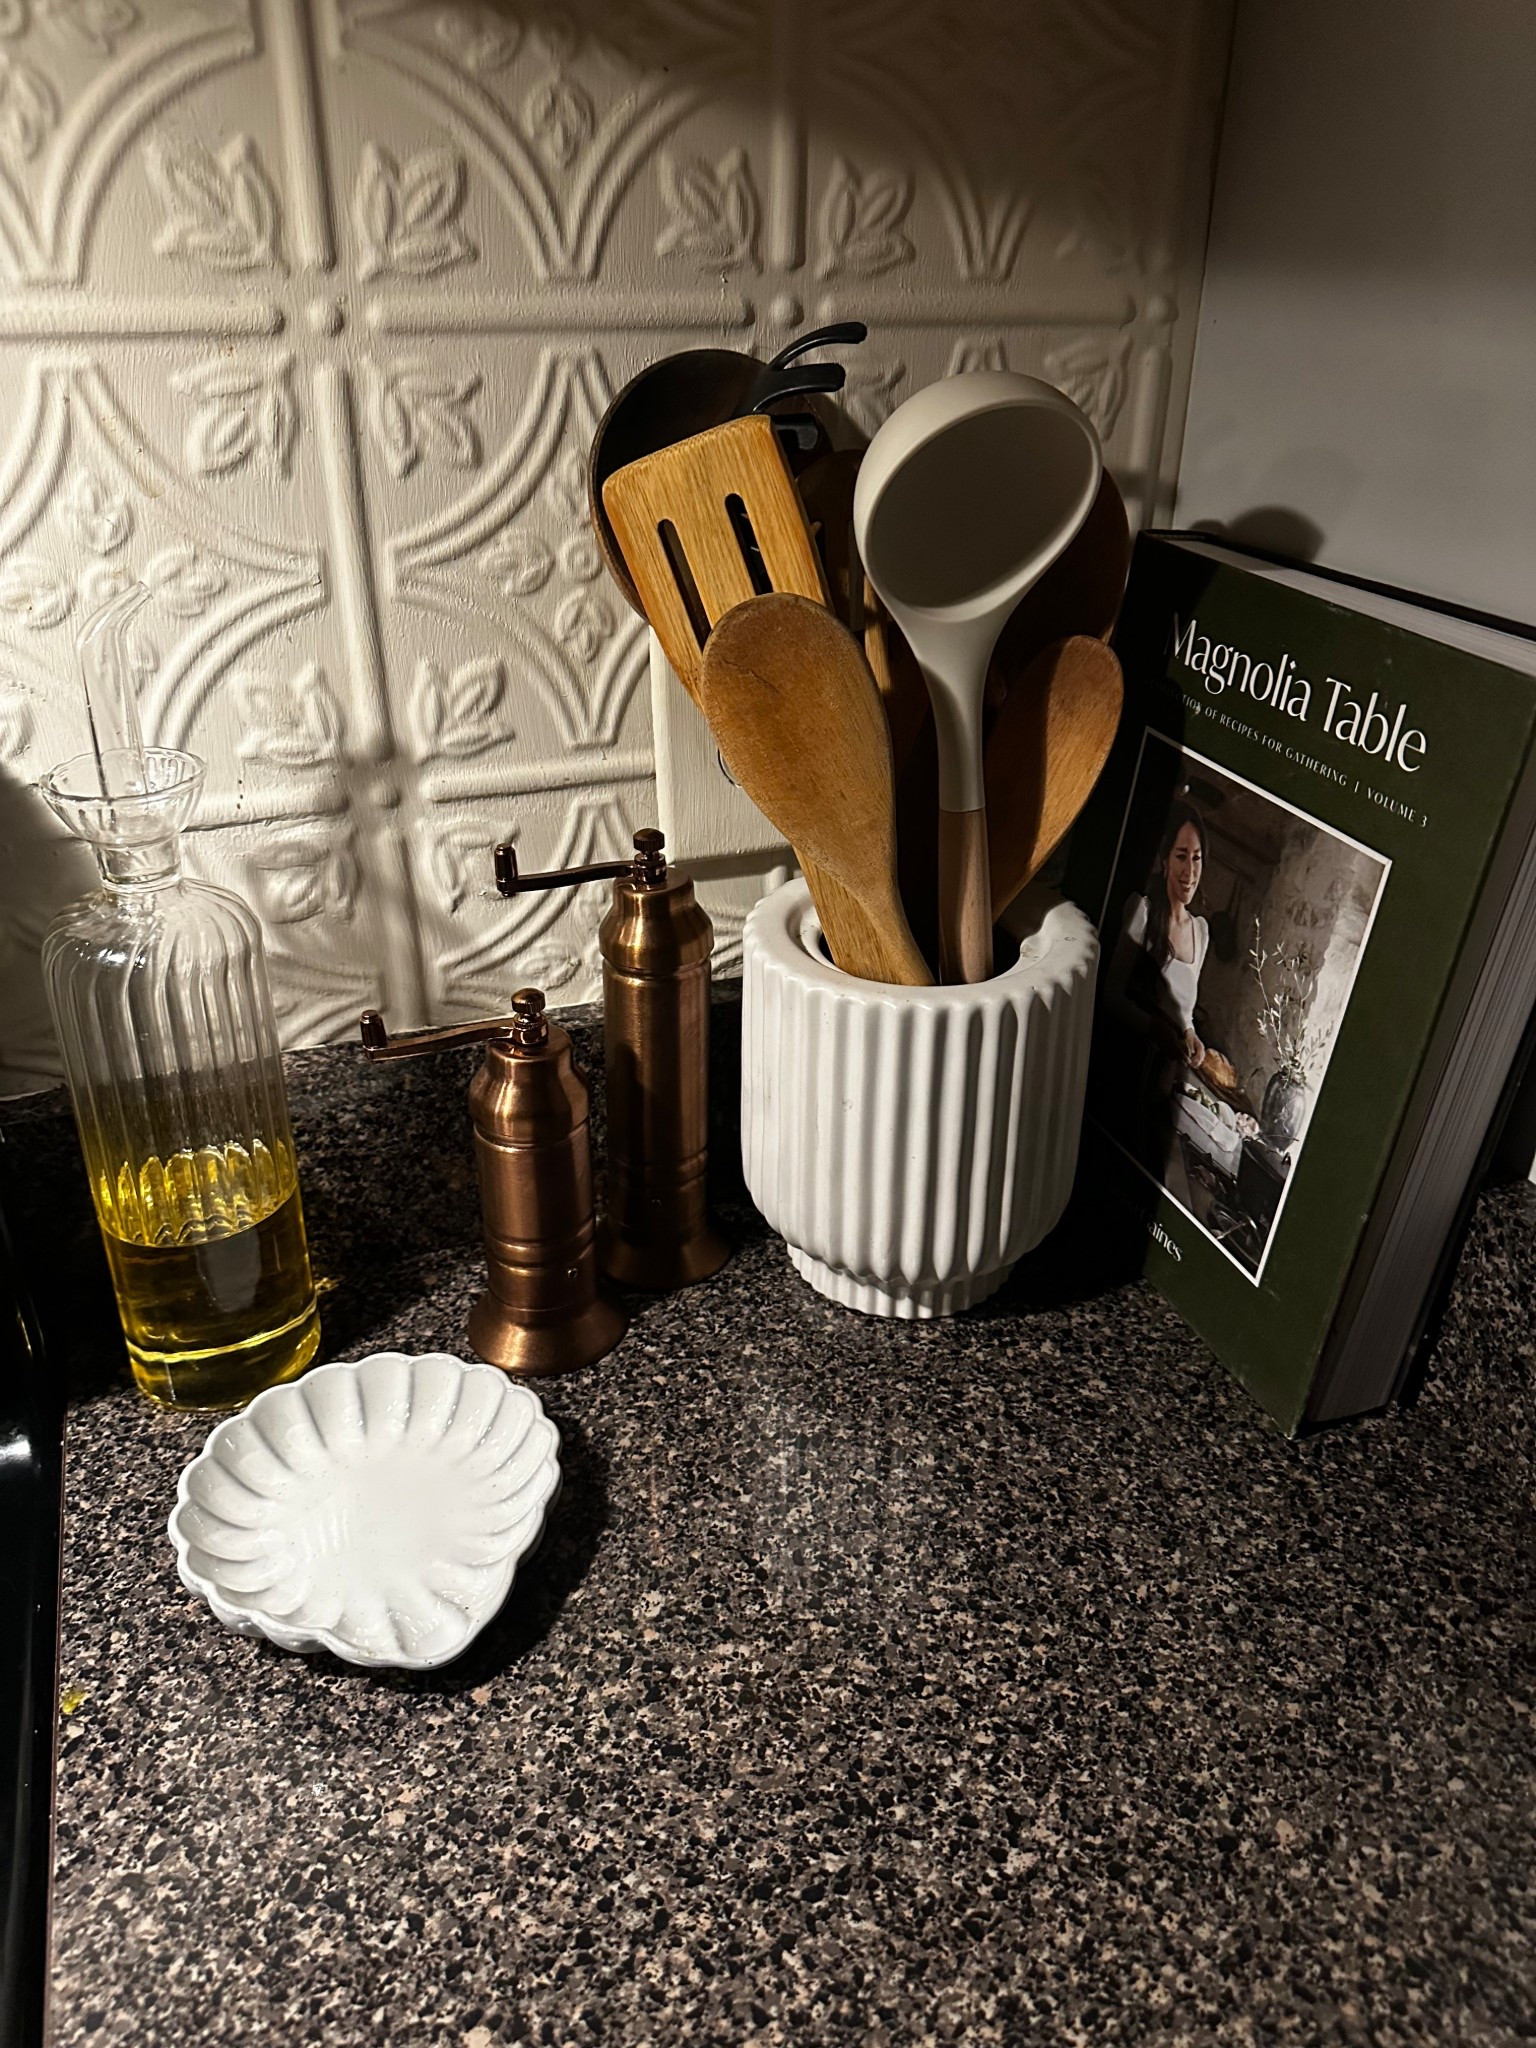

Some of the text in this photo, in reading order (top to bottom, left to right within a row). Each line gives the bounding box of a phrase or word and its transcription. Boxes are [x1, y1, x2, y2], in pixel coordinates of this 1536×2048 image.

[1164, 611, 1427, 772] Magnolia Table
[1204, 706, 1218, 720] OF
[1219, 713, 1259, 741] RECIPES
[1261, 734, 1283, 753] FOR
[1285, 747, 1348, 786] GATHERING
[1367, 787, 1416, 822] VOLUME
[1420, 815, 1428, 828] 3
[1147, 1219, 1184, 1262] aines
